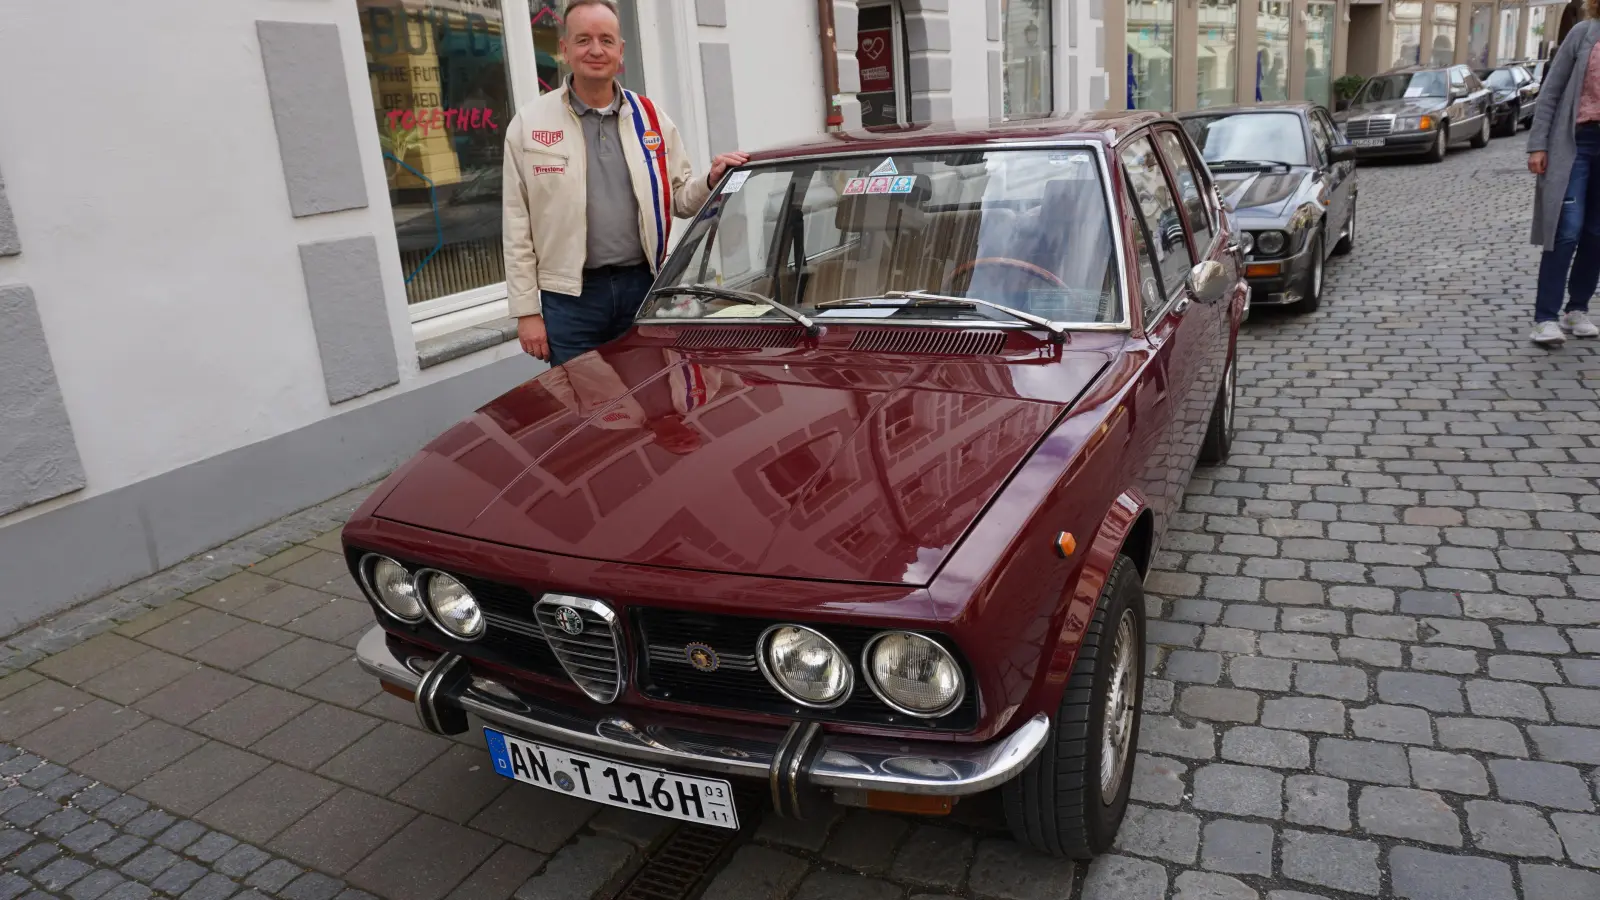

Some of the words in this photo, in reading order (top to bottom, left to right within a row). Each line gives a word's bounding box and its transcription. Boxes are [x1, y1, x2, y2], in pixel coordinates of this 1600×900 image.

[371, 7, 488, 56] BUILD
[380, 66, 408, 82] THE
[383, 93, 402, 109] OF
[386, 106, 498, 136] TOGETHER
[533, 131, 562, 145] HEUER
[535, 165, 564, 174] Firestone
[498, 758, 507, 769] D
[510, 742, 553, 786] AN
[570, 758, 592, 795] T
[602, 767, 705, 818] 116H
[704, 786, 724, 798] 03
[711, 810, 728, 823] 11
